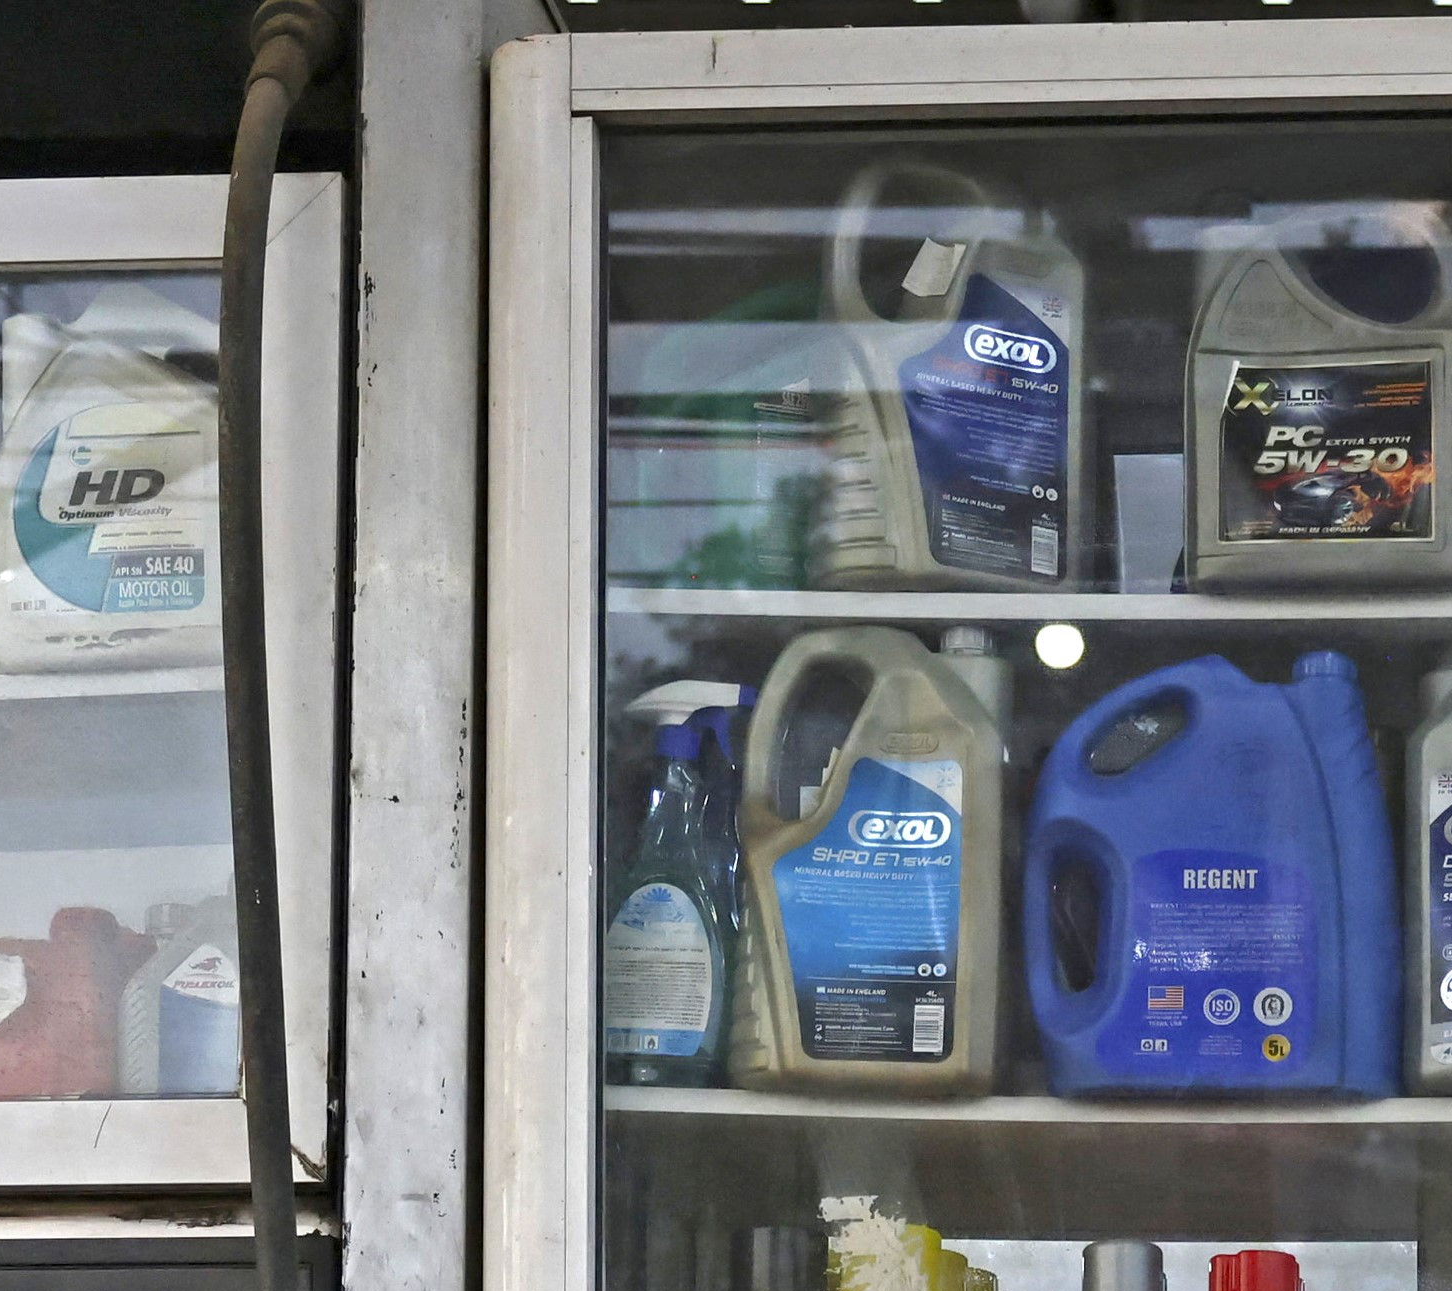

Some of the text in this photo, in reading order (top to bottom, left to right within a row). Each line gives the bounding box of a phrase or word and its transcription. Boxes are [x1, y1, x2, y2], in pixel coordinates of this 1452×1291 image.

[1265, 425, 1325, 447] PC
[1253, 448, 1409, 474] 5W-30
[68, 468, 166, 507] HD
[145, 555, 195, 575] SAE 40
[118, 579, 193, 598] MOTOR OIL
[811, 847, 870, 865] SHPD
[872, 852, 901, 867] E7
[1183, 868, 1259, 890] REGENT
[854, 988, 887, 996] ENGLAND
[1211, 999, 1234, 1012] ISO
